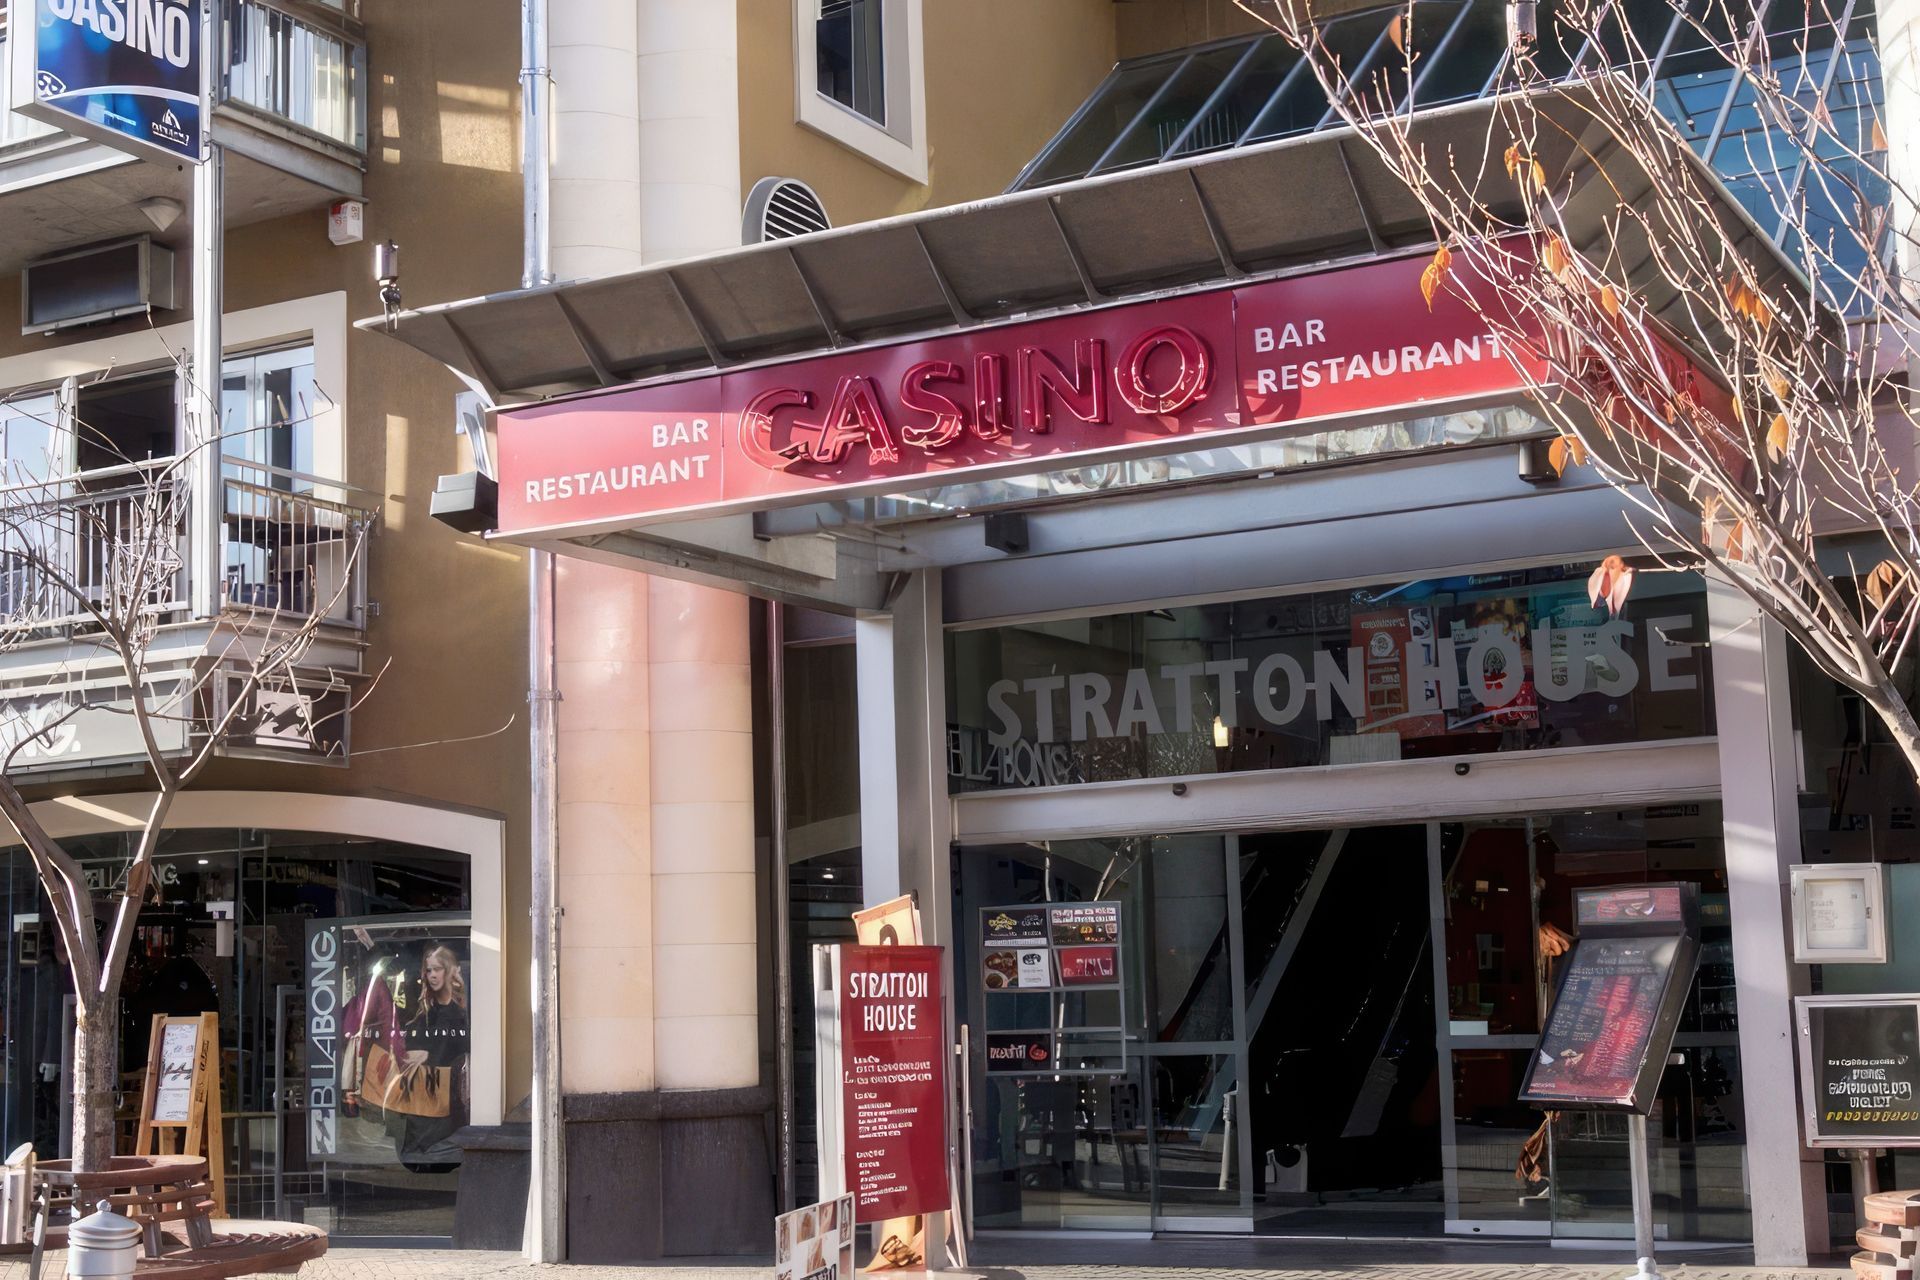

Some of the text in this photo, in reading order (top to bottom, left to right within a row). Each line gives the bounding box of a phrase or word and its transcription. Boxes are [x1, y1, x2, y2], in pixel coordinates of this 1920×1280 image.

[1254, 319, 1327, 353] BAR
[1257, 331, 1502, 395] RESTAURANT
[738, 325, 1215, 472] CASINO
[651, 418, 709, 448] BAR
[525, 455, 710, 503] RESTAURANT
[986, 613, 1698, 745] STRATTON HOUSE
[849, 972, 929, 999] STRATTON
[863, 1004, 917, 1032] HOUSE
